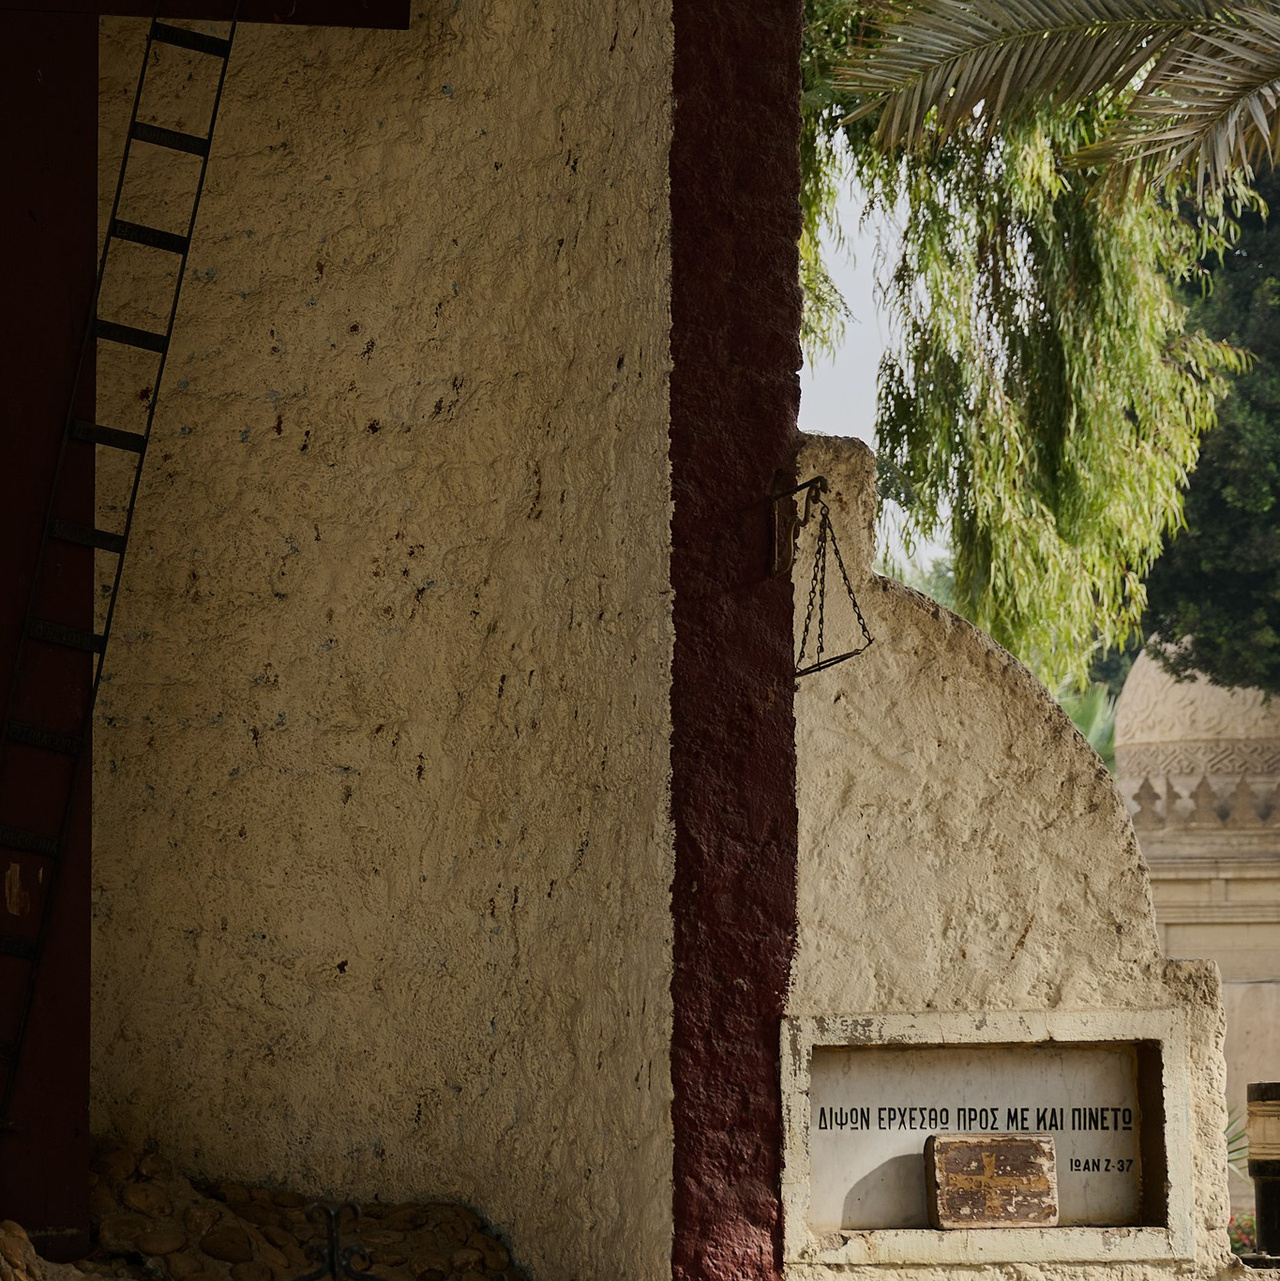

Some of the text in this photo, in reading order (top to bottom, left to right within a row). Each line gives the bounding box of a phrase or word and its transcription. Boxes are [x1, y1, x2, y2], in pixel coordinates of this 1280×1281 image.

[957, 1107, 999, 1130] ΠΡΟΣ
[1006, 1107, 1029, 1131] ΜΕ
[1036, 1107, 1064, 1131] ΚΑΙ
